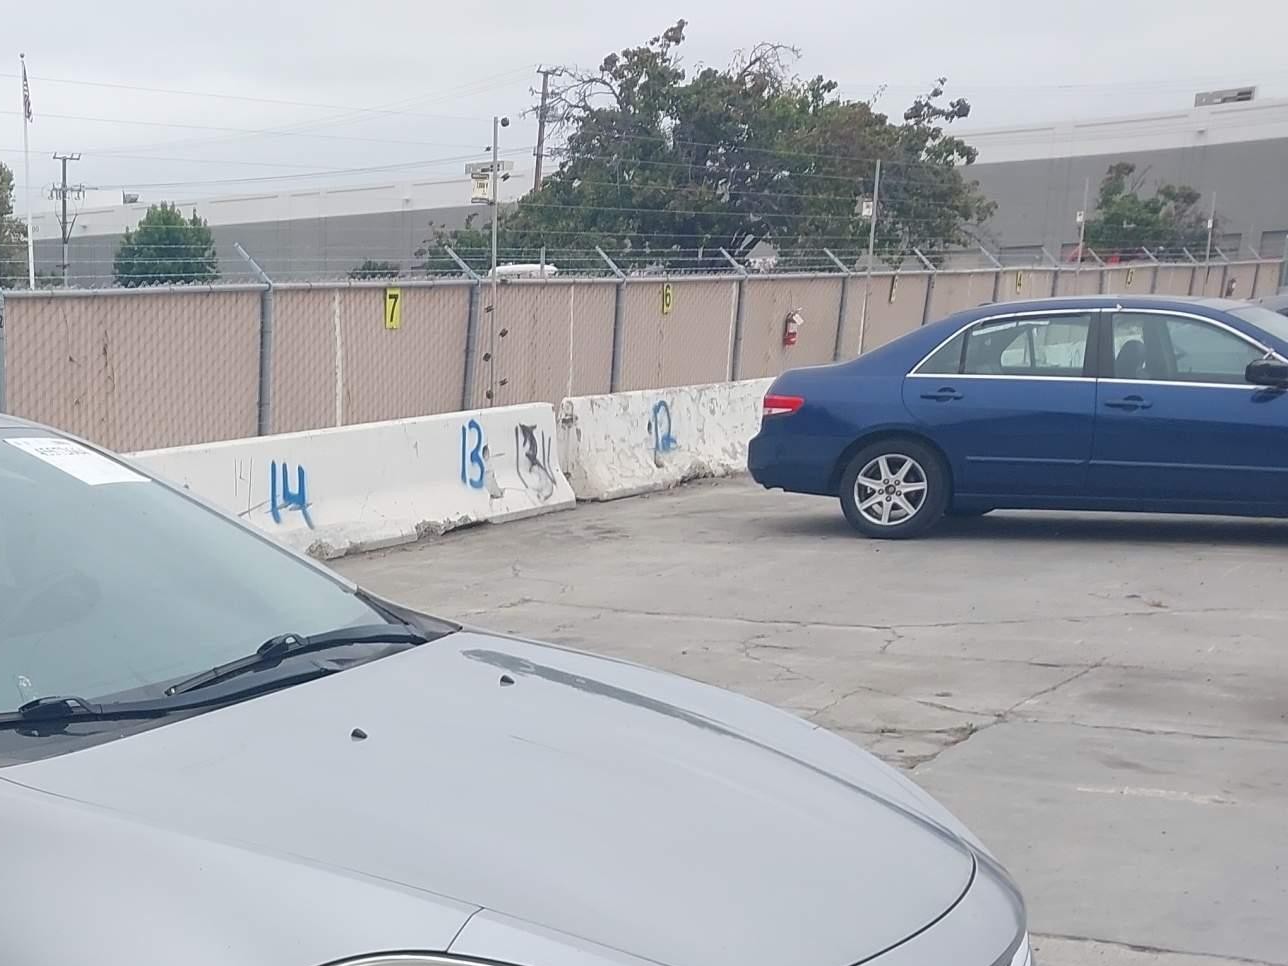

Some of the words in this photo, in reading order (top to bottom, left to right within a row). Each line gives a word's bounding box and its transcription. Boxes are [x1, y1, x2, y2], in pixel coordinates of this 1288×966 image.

[388, 294, 399, 322] 7
[665, 284, 671, 308] 6
[270, 460, 314, 529] 14
